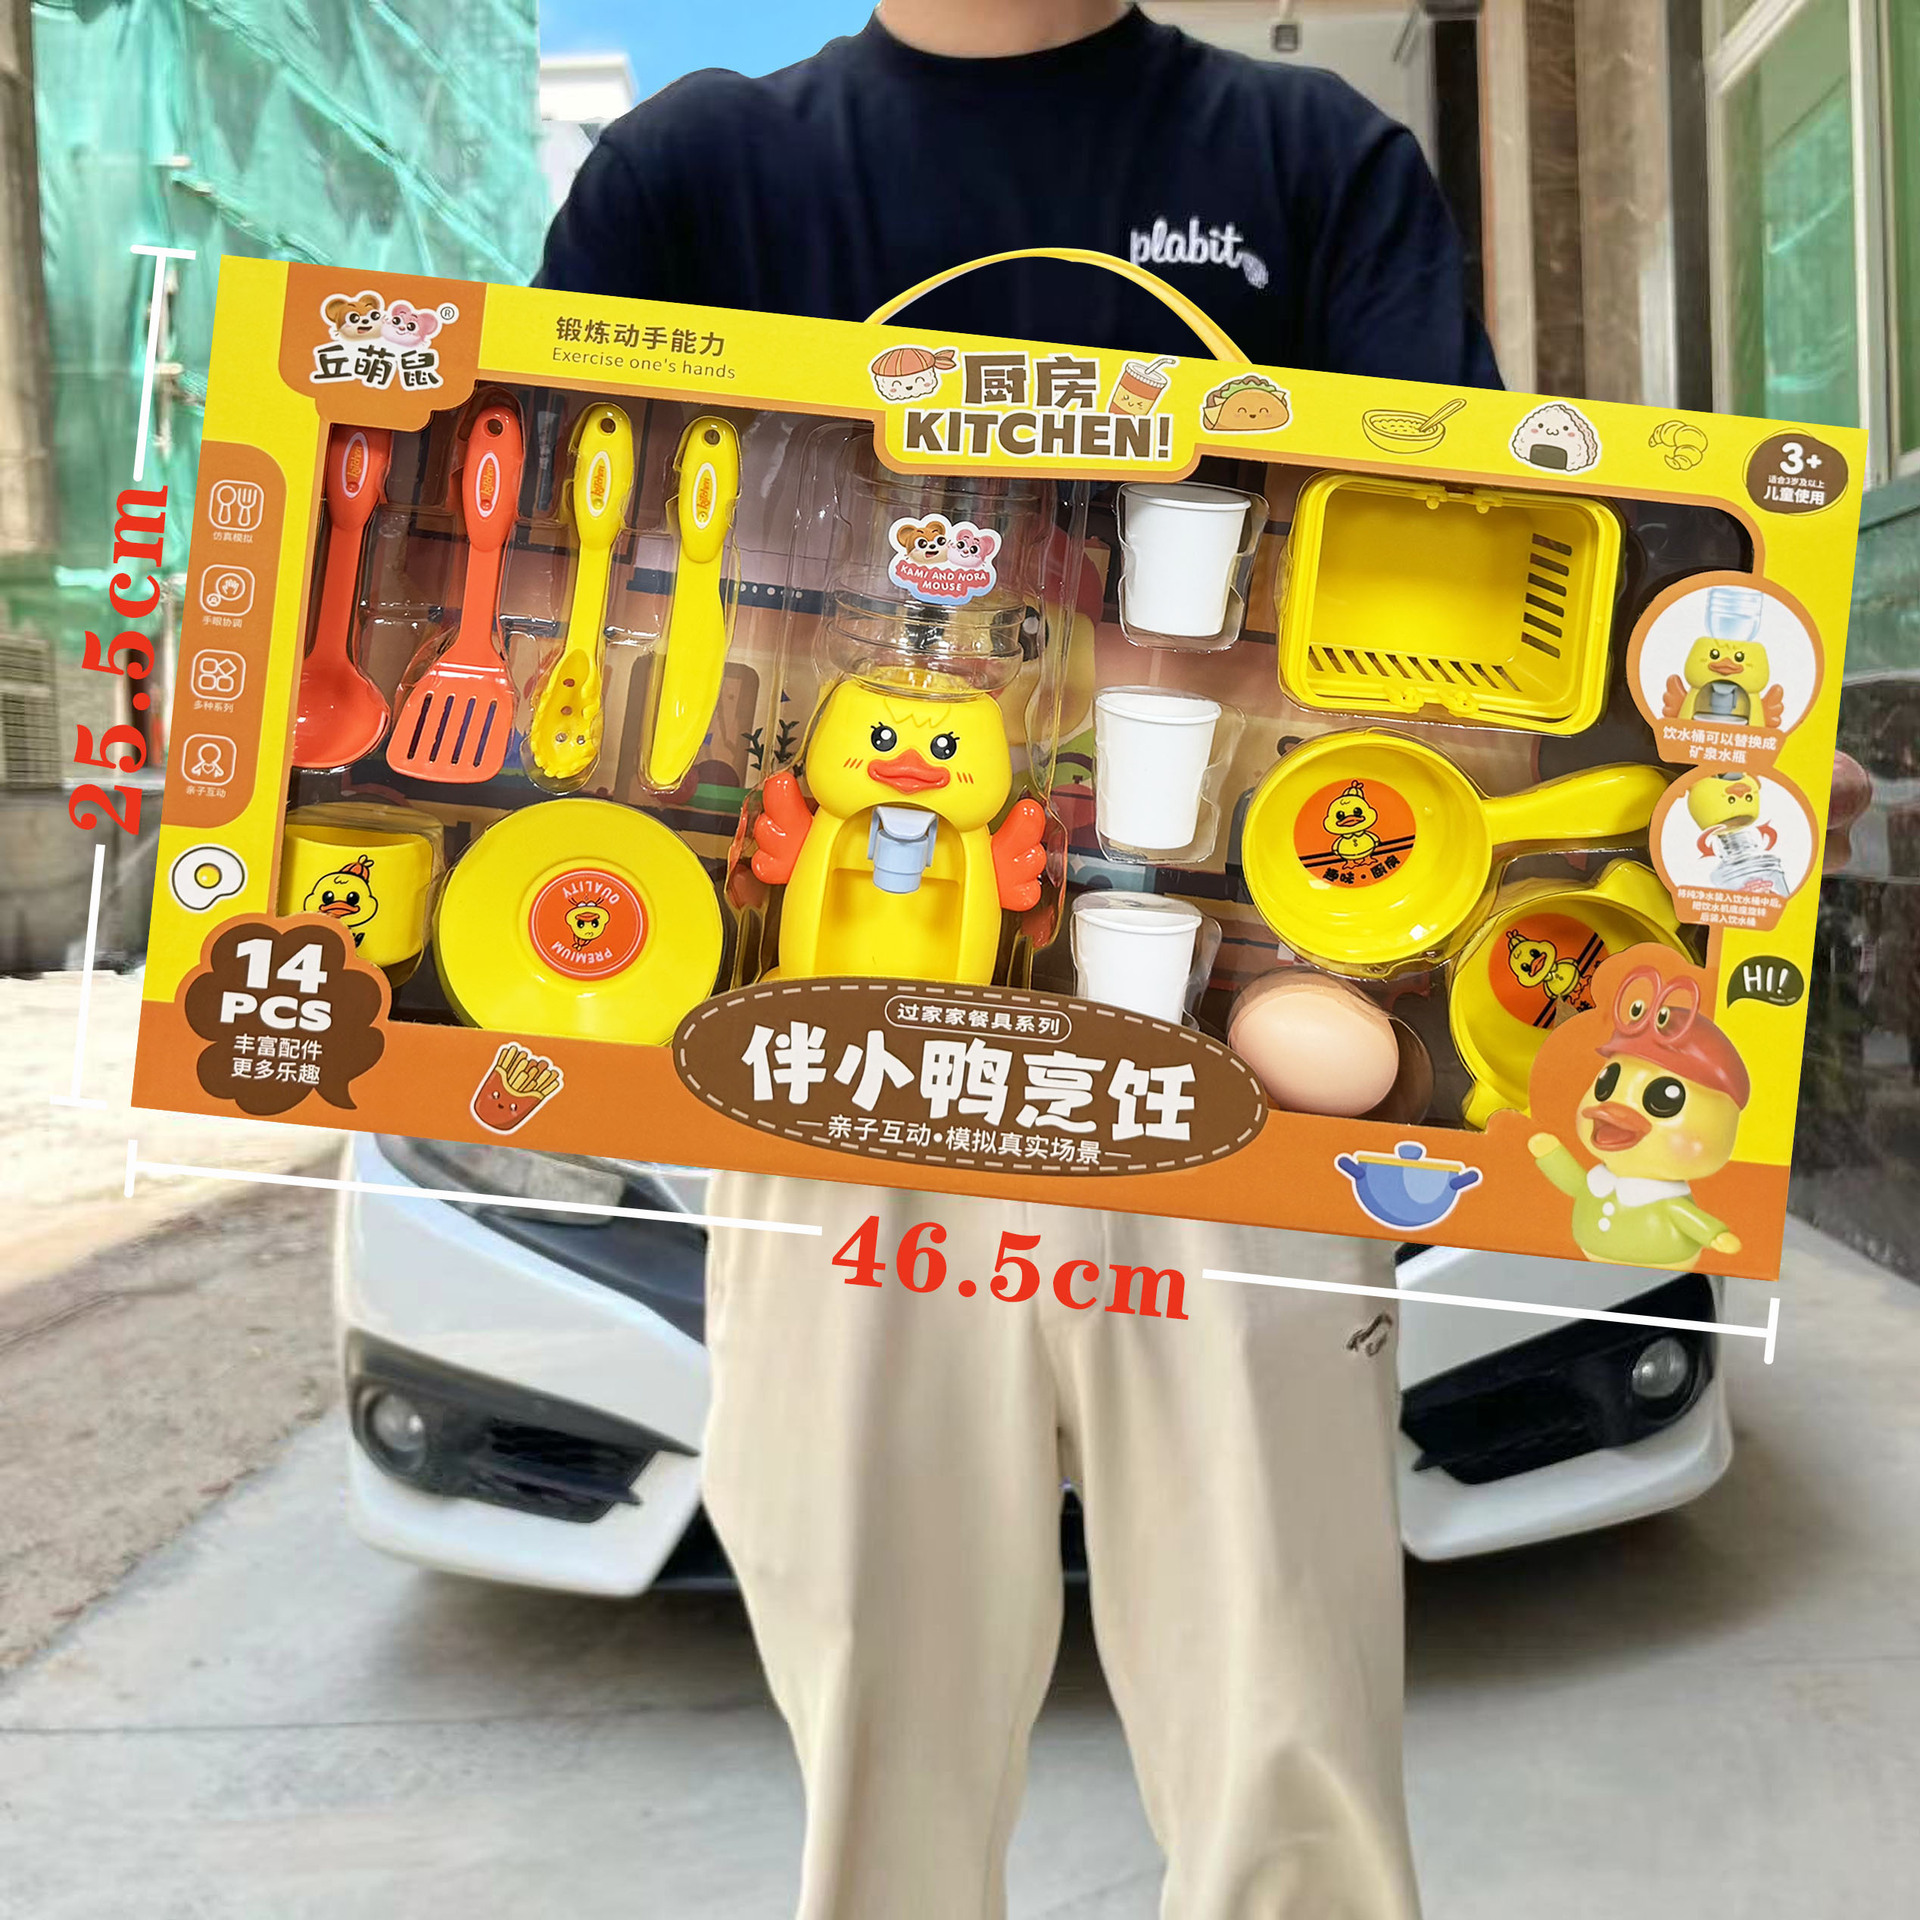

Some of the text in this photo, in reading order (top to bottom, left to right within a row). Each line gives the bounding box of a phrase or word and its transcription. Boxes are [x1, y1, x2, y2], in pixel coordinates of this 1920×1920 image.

[556, 316, 725, 357] 锻炼动手能力
[314, 344, 439, 387] 丘萌鼠
[553, 347, 736, 379] Exercise one's hands
[964, 355, 1097, 408] 厨房
[906, 411, 1171, 459] KITCHEN!
[1780, 442, 1822, 475] 3+
[1763, 486, 1825, 505] 儿童使用
[1768, 475, 1825, 489] 适合3岁及以上
[213, 532, 253, 544] 仿真模拟
[900, 564, 987, 582] KAMI AND NORA
[922, 581, 962, 592] MOUSE
[202, 616, 243, 628] 手眼协调
[193, 700, 234, 713] 多种系列
[1663, 726, 1777, 750] 饮水桶可以替换成
[1689, 745, 1747, 764] 矿泉水瓶
[186, 786, 227, 799] 亲子互动
[562, 880, 621, 905] QUALITY
[236, 938, 328, 994] 14
[550, 940, 613, 964] PREMIUM
[1743, 964, 1789, 994] HI!
[220, 991, 332, 1032] PCS
[897, 1003, 1061, 1036] 过家家餐具系列
[234, 1033, 323, 1061] 丰富配件
[231, 1057, 321, 1085] 更多乐趣
[741, 1021, 1196, 1141] 伴小鸭烹饪
